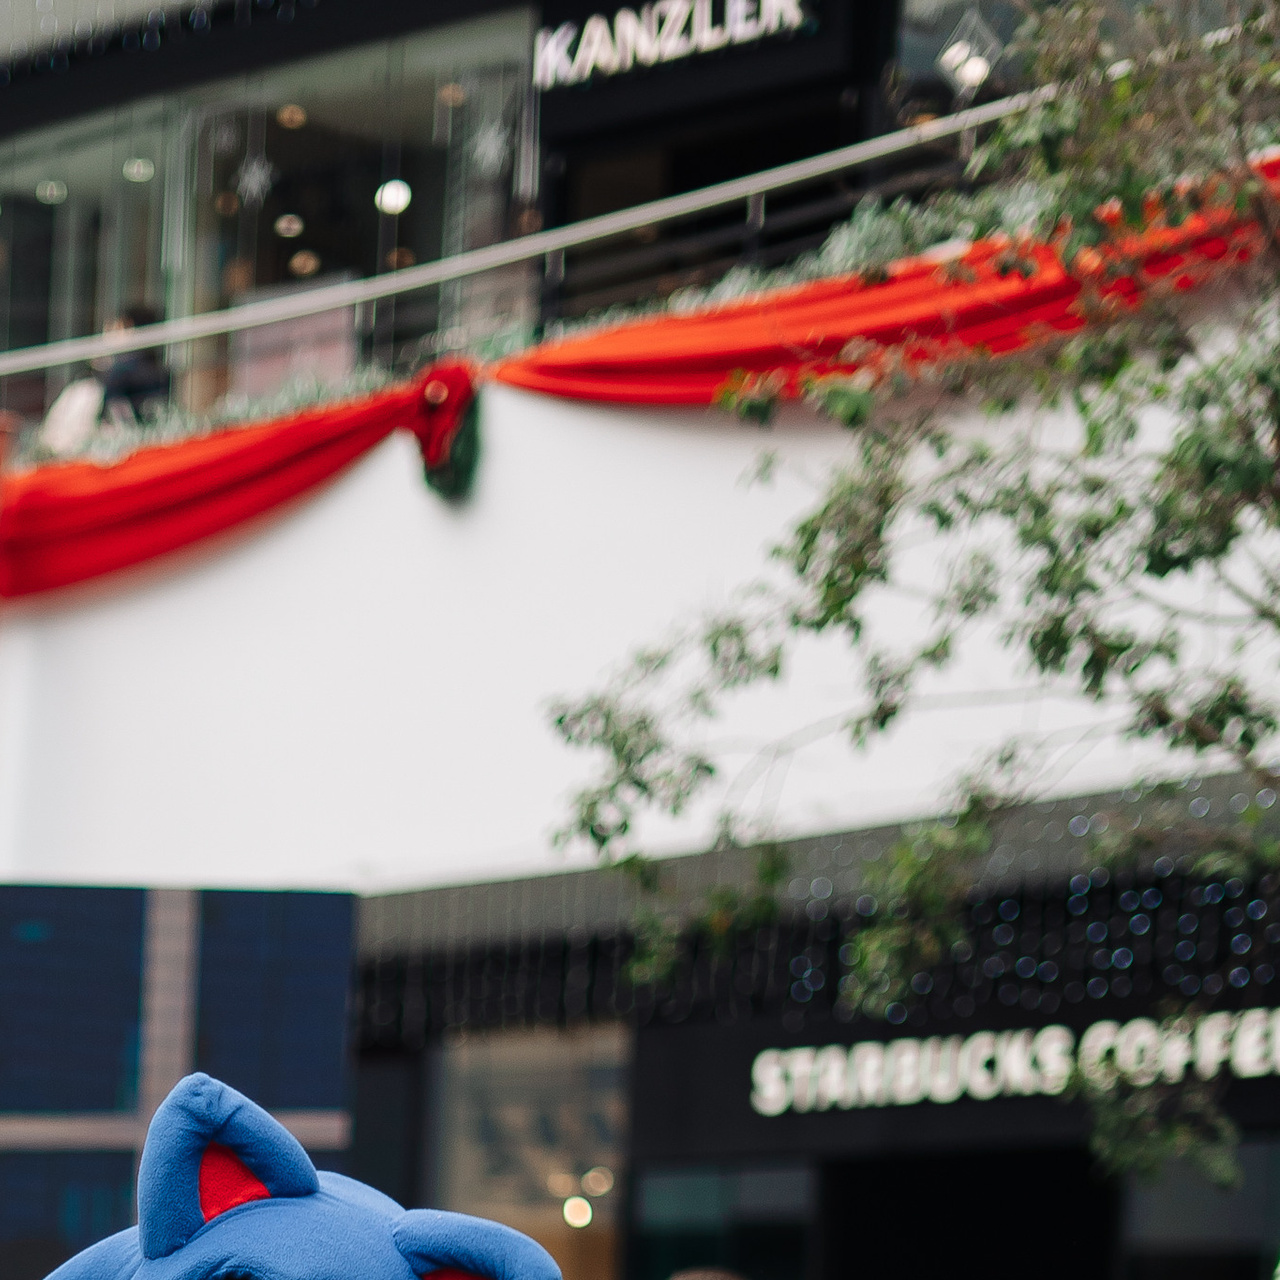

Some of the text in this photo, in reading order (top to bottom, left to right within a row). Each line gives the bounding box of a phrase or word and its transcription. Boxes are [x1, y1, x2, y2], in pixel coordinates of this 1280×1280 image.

[532, 0, 806, 92] KANZLER
[751, 1005, 1280, 1117] STARBUCKS COFFE
